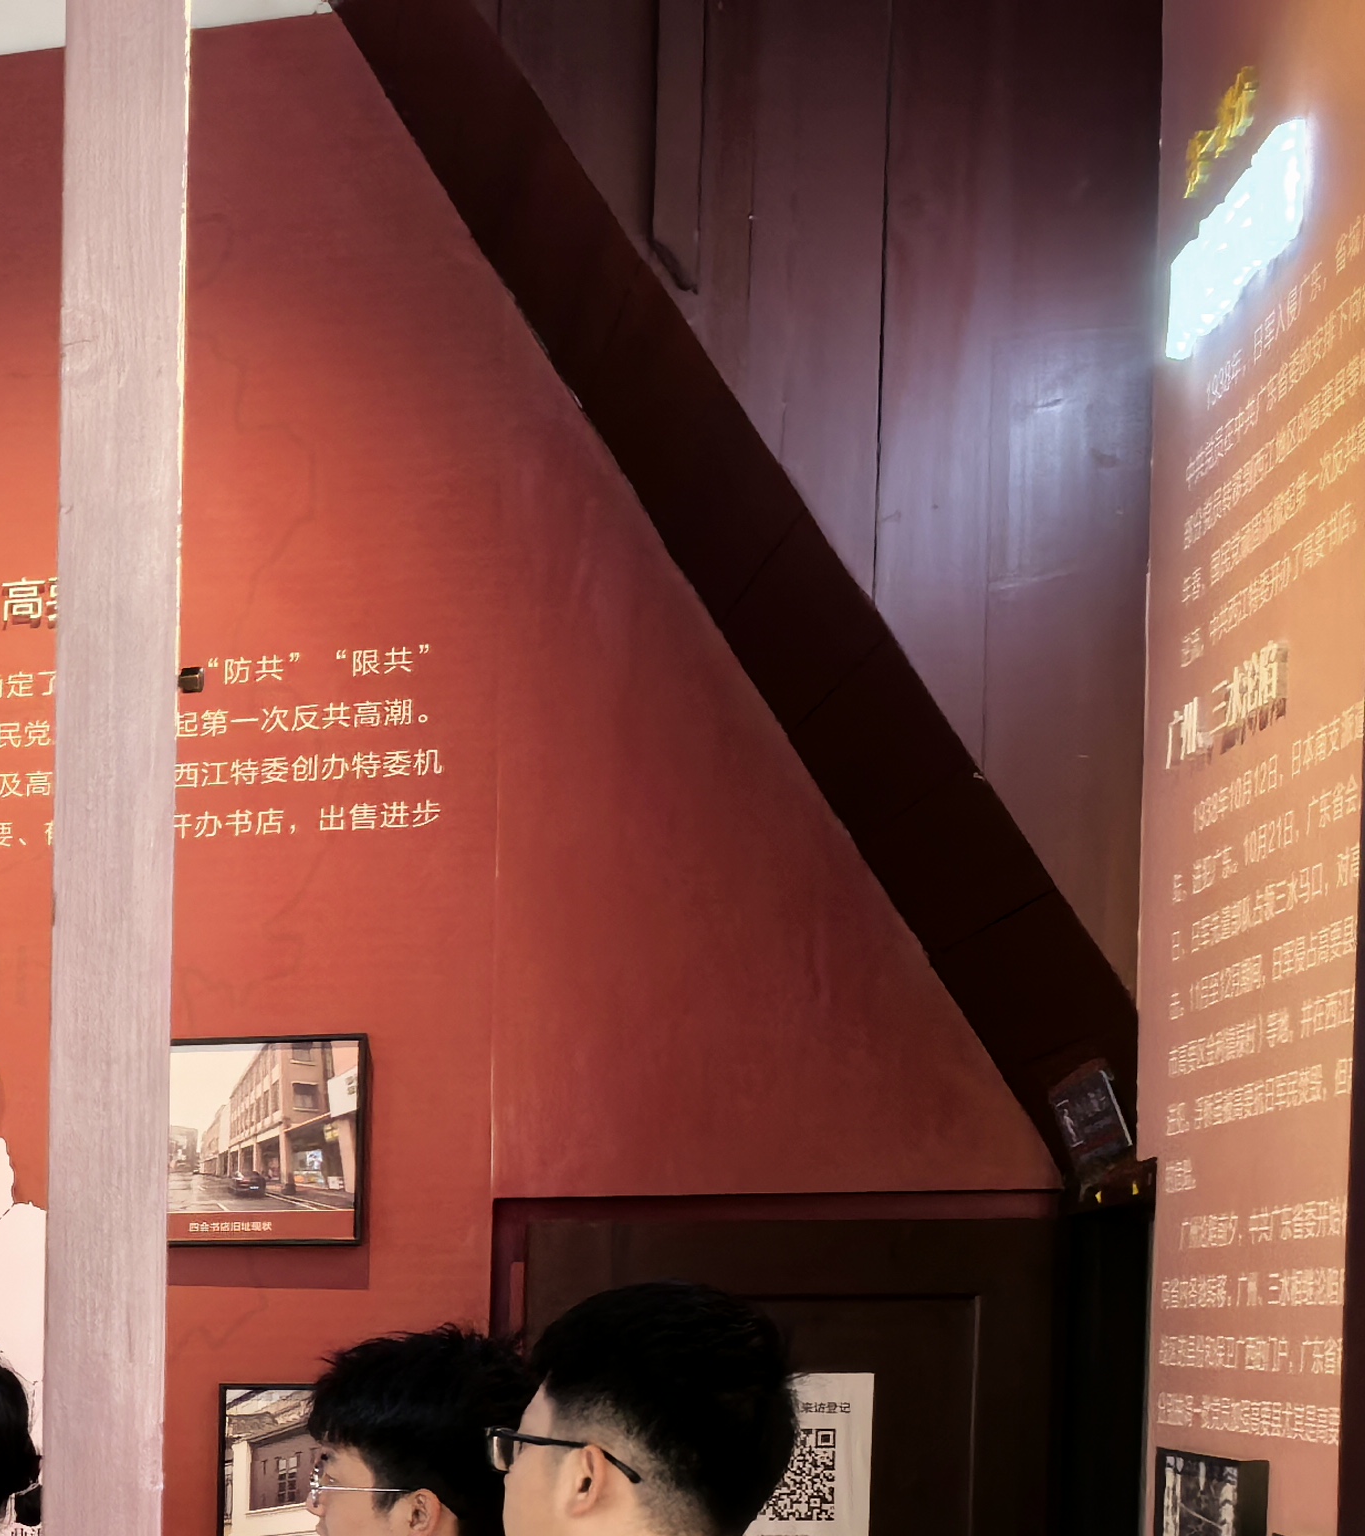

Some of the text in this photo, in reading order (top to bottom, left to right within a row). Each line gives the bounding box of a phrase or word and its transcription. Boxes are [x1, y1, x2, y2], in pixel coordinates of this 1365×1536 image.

[175, 749, 445, 789] 西江特委创办特委机
